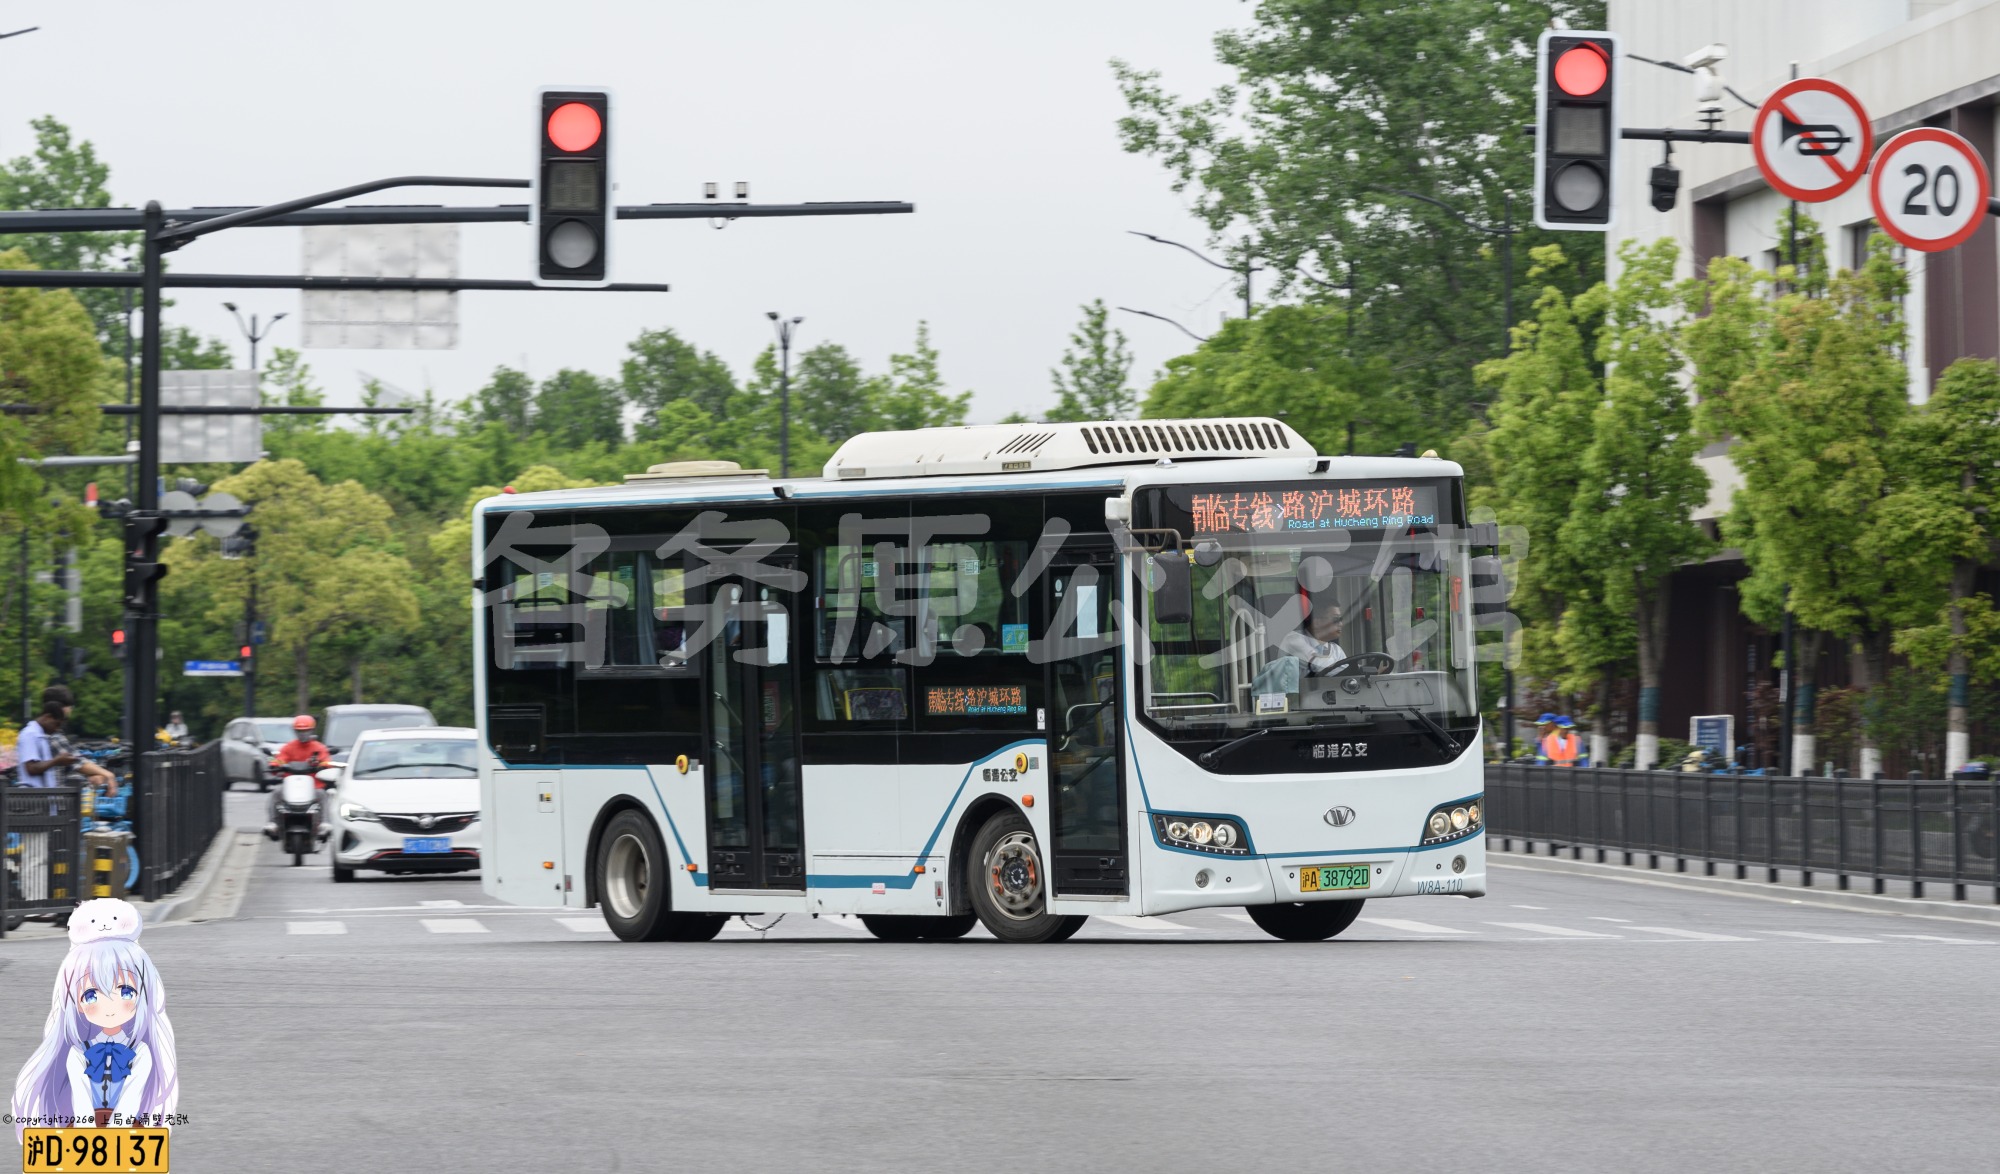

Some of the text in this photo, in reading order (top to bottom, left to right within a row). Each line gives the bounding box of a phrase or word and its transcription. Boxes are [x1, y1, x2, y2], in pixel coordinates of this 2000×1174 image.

[1902, 163, 1960, 217] 20
[1282, 486, 1415, 520] 路沪城环路
[1288, 514, 1434, 529] Road at Hucheng Ring Road
[967, 686, 1022, 706] 路沪城环路
[1312, 742, 1368, 759] 临港公交
[1417, 879, 1463, 895] W8A-110
